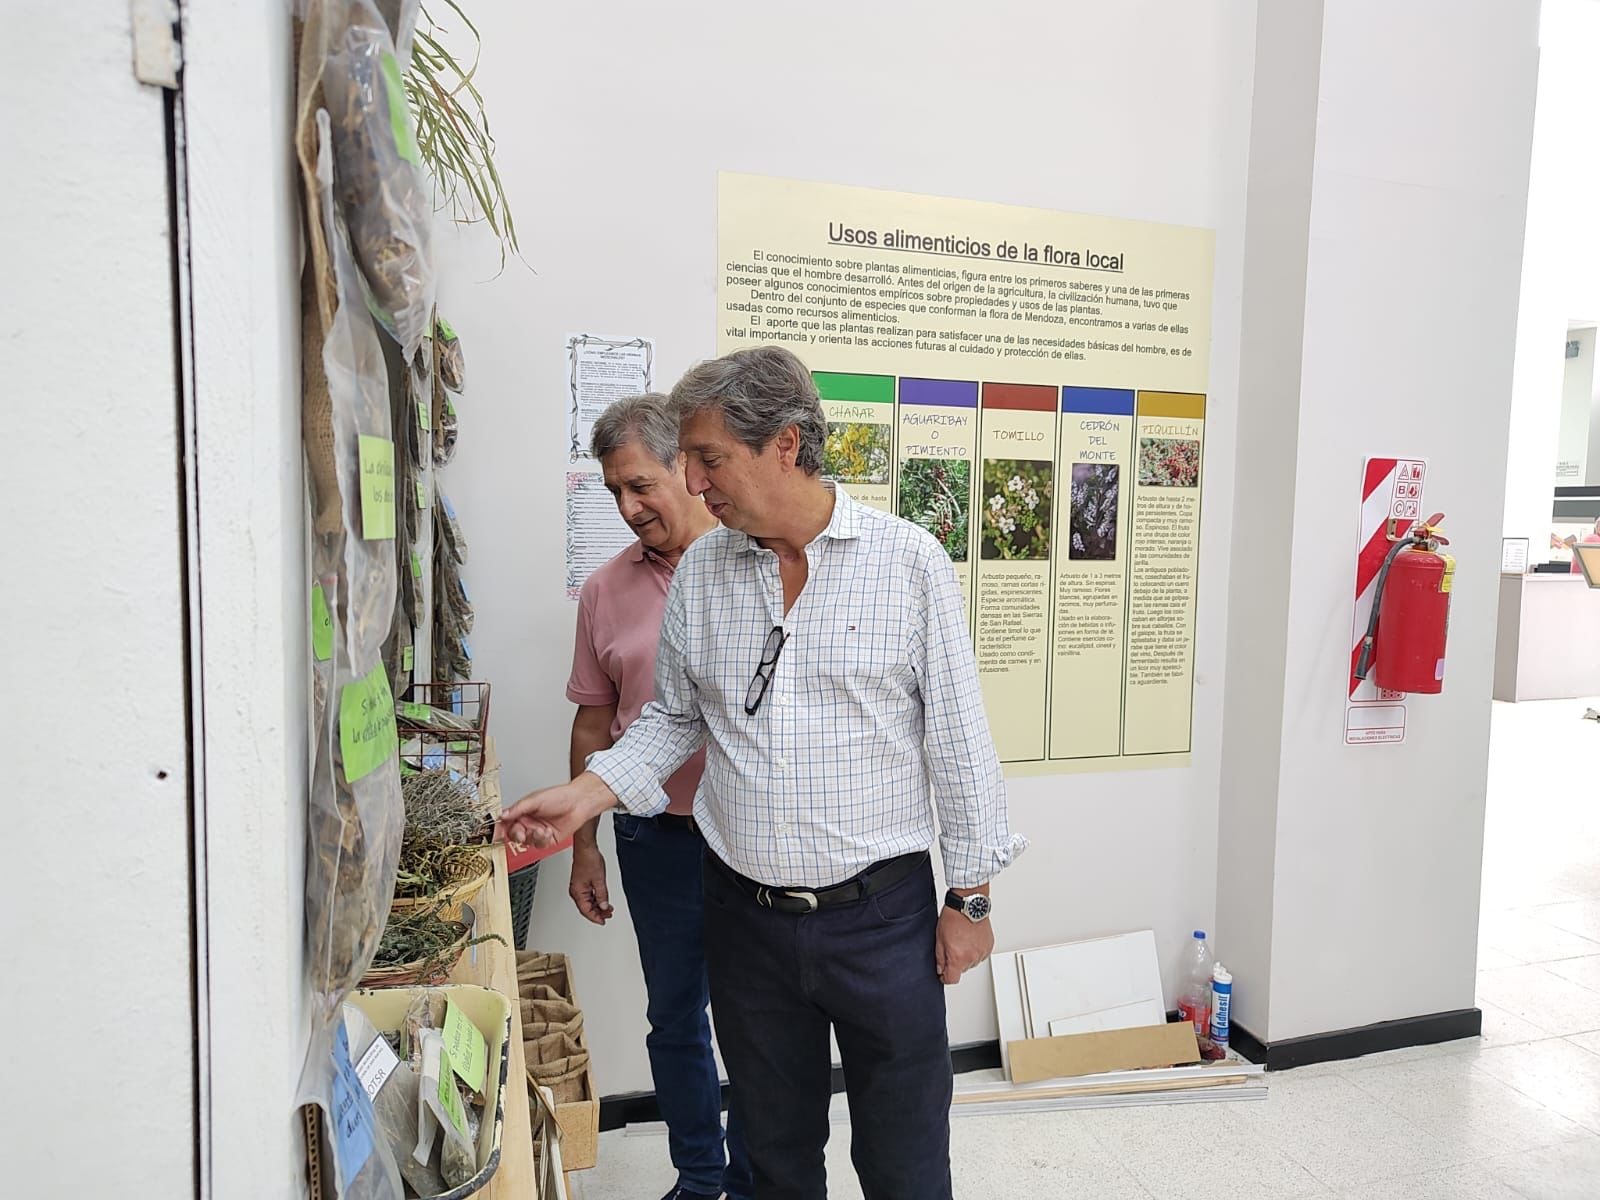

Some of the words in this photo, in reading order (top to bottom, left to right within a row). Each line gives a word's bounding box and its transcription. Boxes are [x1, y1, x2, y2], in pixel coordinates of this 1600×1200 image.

[829, 222, 877, 245] Usos
[883, 228, 990, 256] alimenticios
[996, 239, 1018, 259] de
[1023, 242, 1038, 261] la
[1043, 244, 1080, 265] flora
[1086, 249, 1123, 270] local
[753, 250, 763, 260] El
[766, 251, 832, 267] conocimiento
[835, 257, 862, 270] sobre
[865, 260, 899, 275] plantas
[902, 263, 959, 280] alimenticias,
[961, 269, 987, 282] figura
[989, 273, 1012, 283] entre
[1014, 274, 1027, 285] los
[1029, 275, 1067, 290] primeros
[1068, 279, 1102, 292] saberes
[1104, 285, 1109, 294] y
[1111, 285, 1127, 294] una
[1129, 285, 1139, 295] de
[1141, 287, 1153, 296] las
[1155, 288, 1189, 301] primeras
[726, 260, 768, 274] ciencias
[770, 266, 789, 278] que
[792, 266, 801, 277] el
[804, 267, 842, 281] hombre
[844, 271, 894, 285] desarrolló.
[897, 276, 924, 288] Antes
[926, 278, 940, 289] del
[942, 280, 971, 293] origen
[973, 282, 985, 293] de
[987, 284, 995, 294] la
[997, 285, 1046, 300] agricultura,
[1048, 289, 1056, 299] la
[1058, 290, 1103, 303] civilización
[1105, 294, 1141, 308] humana,
[1143, 299, 1160, 308] tuvo
[1162, 301, 1177, 311] que
[726, 276, 762, 288] poseer
[764, 277, 803, 292] algunos
[806, 280, 876, 296] conocimientos
[878, 286, 924, 302] empíricos
[926, 291, 952, 303] sobre
[954, 293, 1009, 309] propiedades
[1011, 300, 1017, 310] y
[1019, 301, 1040, 310] usos
[1042, 301, 1053, 311] de
[1055, 302, 1067, 312] las
[1069, 303, 1102, 317] plantas.
[726, 299, 763, 312] usadas
[765, 305, 793, 315] como
[796, 308, 838, 318] recursos
[841, 308, 900, 323] alimenticios.
[750, 289, 785, 301] Dentro
[787, 292, 802, 303] del
[805, 293, 847, 308] conjunto
[849, 297, 862, 308] de
[864, 298, 906, 313] especies
[908, 304, 926, 314] que
[928, 303, 976, 317] conforman
[978, 308, 986, 317] la
[989, 308, 1008, 319] flora
[1010, 310, 1022, 320] de
[1024, 311, 1066, 325] Mendoza,
[1068, 316, 1122, 328] encontramos
[1157, 322, 1168, 332] de
[1170, 323, 1188, 334] ellas
[750, 315, 760, 325] El
[766, 317, 798, 330] aporte
[800, 320, 820, 331] que
[822, 320, 836, 331] las
[839, 322, 874, 335] plantas
[876, 324, 913, 336] realizan
[916, 329, 936, 340] para
[939, 329, 982, 341] satisfacer
[984, 334, 1001, 342] una
[1003, 334, 1014, 344] de
[1016, 334, 1029, 345] las
[1031, 336, 1085, 348] necesidades
[1087, 340, 1119, 351] básicas
[1120, 342, 1133, 352] del
[1135, 344, 1168, 355] hombre,
[1181, 347, 1191, 356] de
[726, 326, 746, 337] vital
[749, 327, 807, 343] importancia
[810, 334, 816, 344] y
[818, 333, 851, 344] orienta
[854, 335, 868, 346] las
[871, 336, 912, 349] acciones
[915, 339, 946, 351] futuras
[948, 342, 956, 352] al
[959, 342, 994, 354] cuidado
[996, 347, 1002, 356] y
[1004, 346, 1049, 359] protección
[1050, 349, 1062, 358] de
[1064, 350, 1085, 360] ellas.
[829, 405, 875, 418] CHAÑAR
[903, 413, 967, 426] AGUARIBAY
[1080, 419, 1120, 431] CEDRÓN
[931, 430, 939, 440] O
[993, 430, 1045, 441] TOMILLO
[1142, 423, 1199, 435] PIQUILLÍN
[1089, 435, 1108, 446] DEL
[906, 445, 967, 457] PIMIENTO
[1079, 450, 1116, 461] MONTE
[1398, 485, 1406, 495] B
[1395, 503, 1403, 514] C
